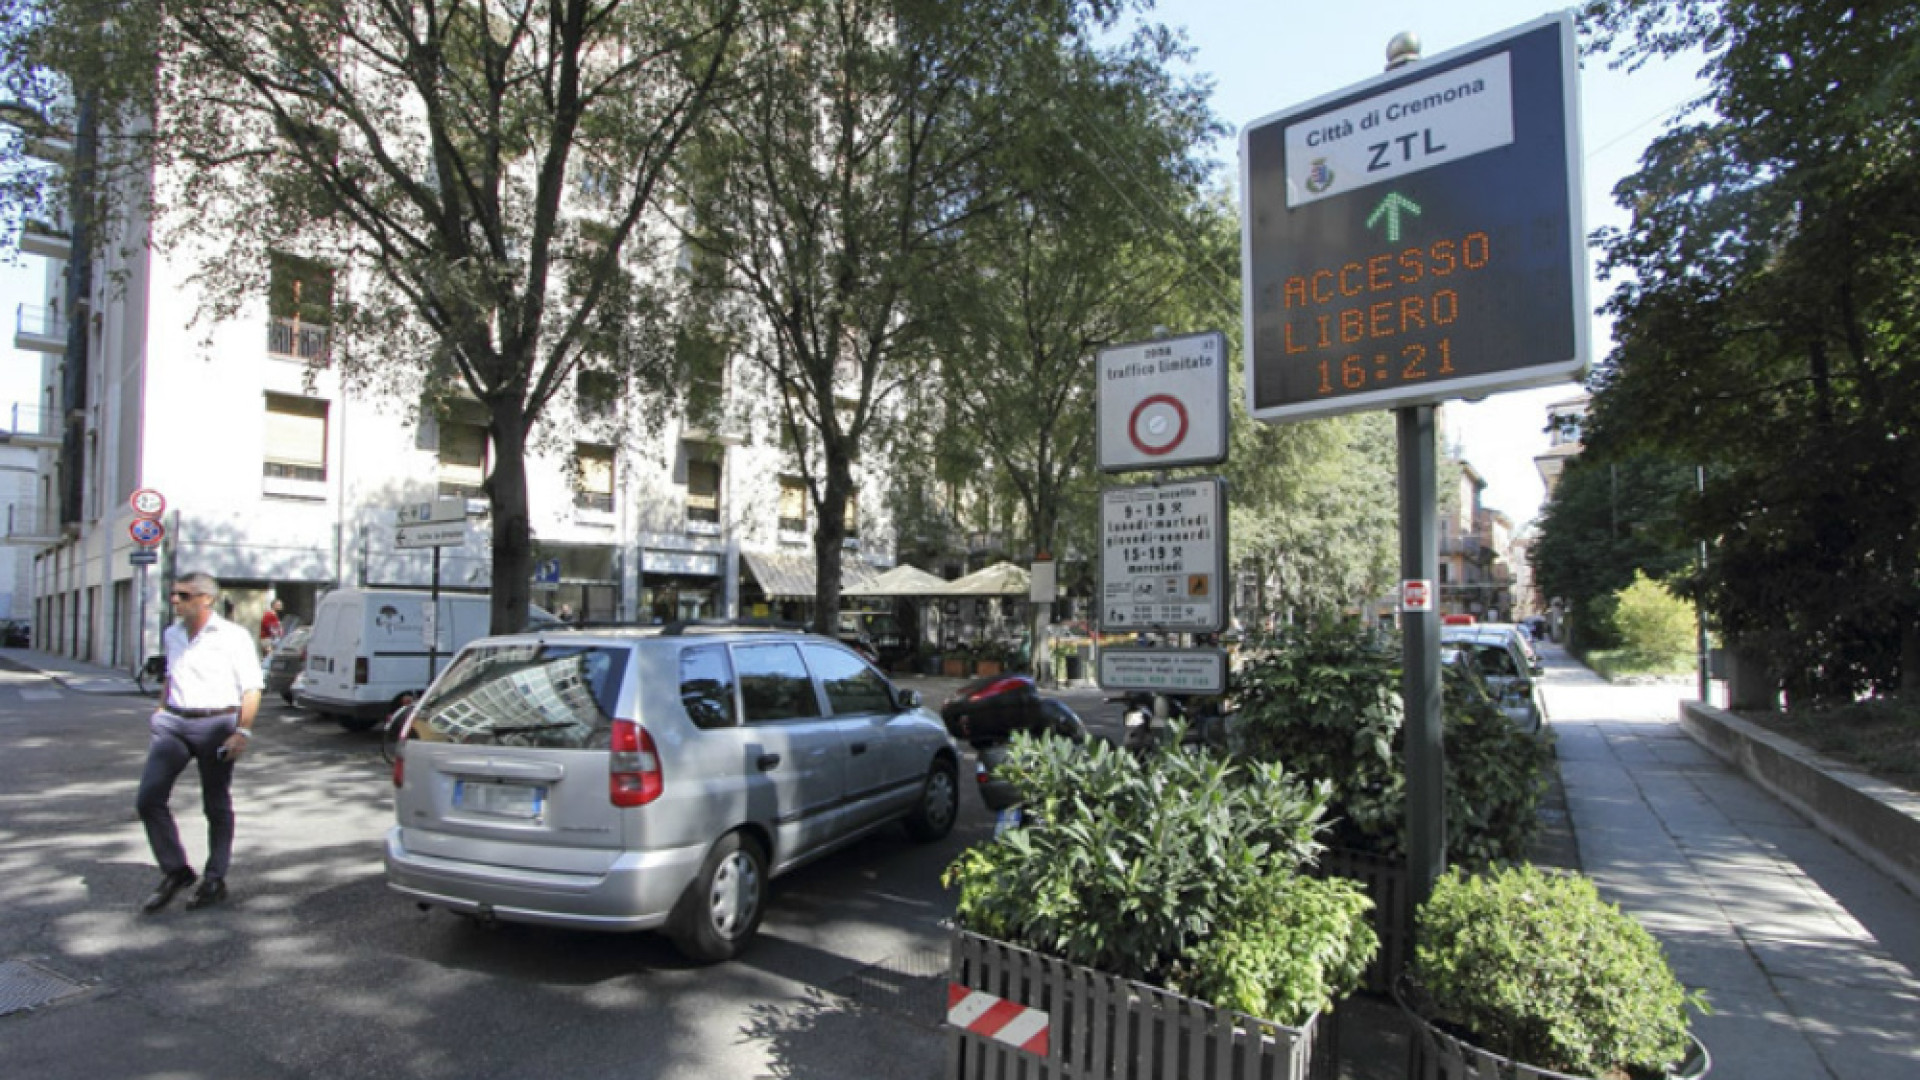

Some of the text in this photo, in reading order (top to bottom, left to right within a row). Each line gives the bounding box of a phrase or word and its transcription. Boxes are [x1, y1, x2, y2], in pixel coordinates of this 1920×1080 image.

[1306, 78, 1485, 147] Città di Cremona
[1367, 127, 1447, 173] ZTL
[1283, 231, 1489, 309] ACCESSO
[1284, 288, 1458, 354] LIBERO
[1107, 354, 1213, 380] traffico limitato
[1318, 337, 1455, 394] 16:21
